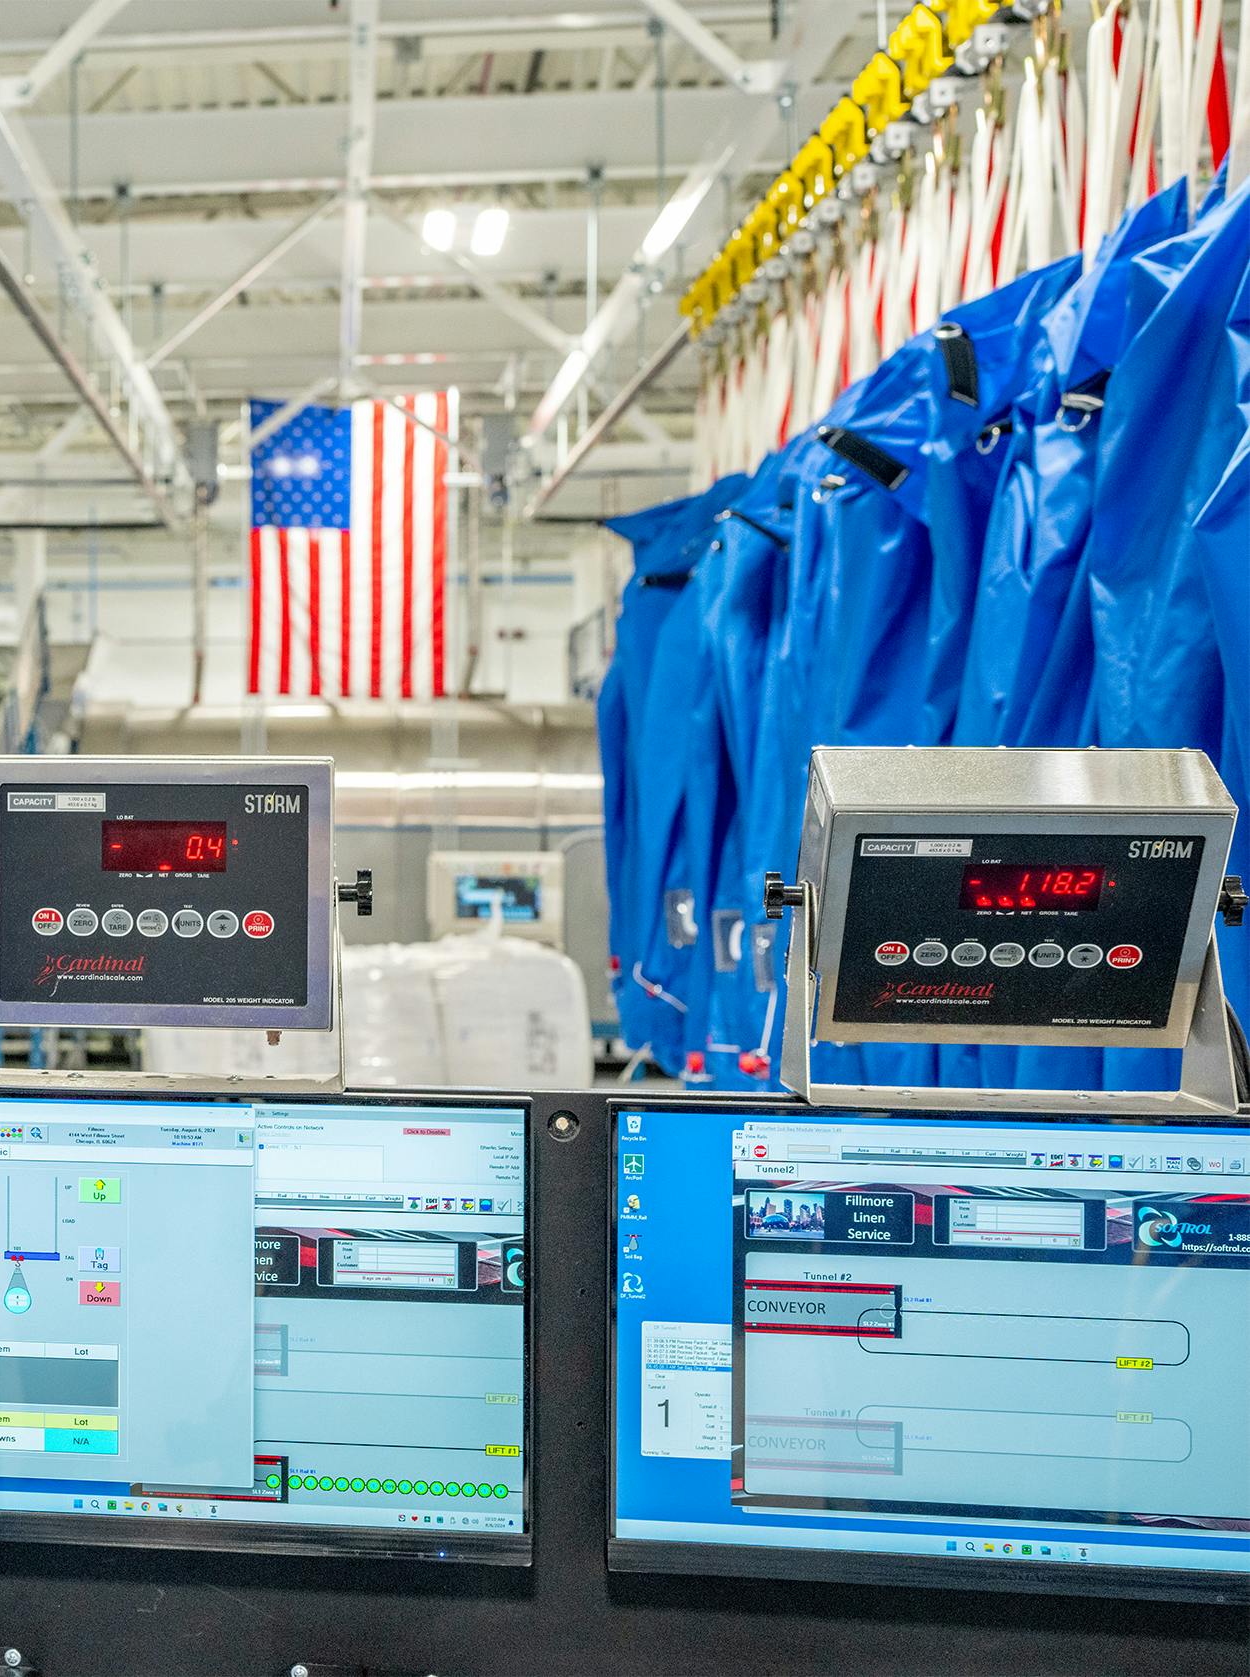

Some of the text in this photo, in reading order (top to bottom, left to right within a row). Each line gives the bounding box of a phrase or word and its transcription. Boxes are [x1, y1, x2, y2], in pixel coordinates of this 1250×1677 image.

[13, 798, 53, 806] CAPACITY
[186, 835, 223, 860] 0.4
[56, 955, 144, 971] Cardinal
[897, 982, 995, 997] Cardinal
[755, 1165, 795, 1174] Tunnel2
[94, 1192, 106, 1201] Up
[845, 1195, 894, 1207] Fillmore
[853, 1212, 885, 1223] Linen
[1155, 1223, 1212, 1234] SOFTROL
[847, 1228, 891, 1240] Service
[91, 1261, 108, 1270] Tag
[803, 1272, 837, 1281] Tunnel
[87, 1294, 112, 1302] Down
[747, 1300, 826, 1314] CONVEYOR
[74, 1348, 88, 1356] Lot
[658, 1400, 669, 1427] 1
[804, 1408, 851, 1417] Tunnel #1
[74, 1418, 88, 1426] Lot
[73, 1437, 90, 1446] N/A
[747, 1436, 826, 1451] CONVEYOR
